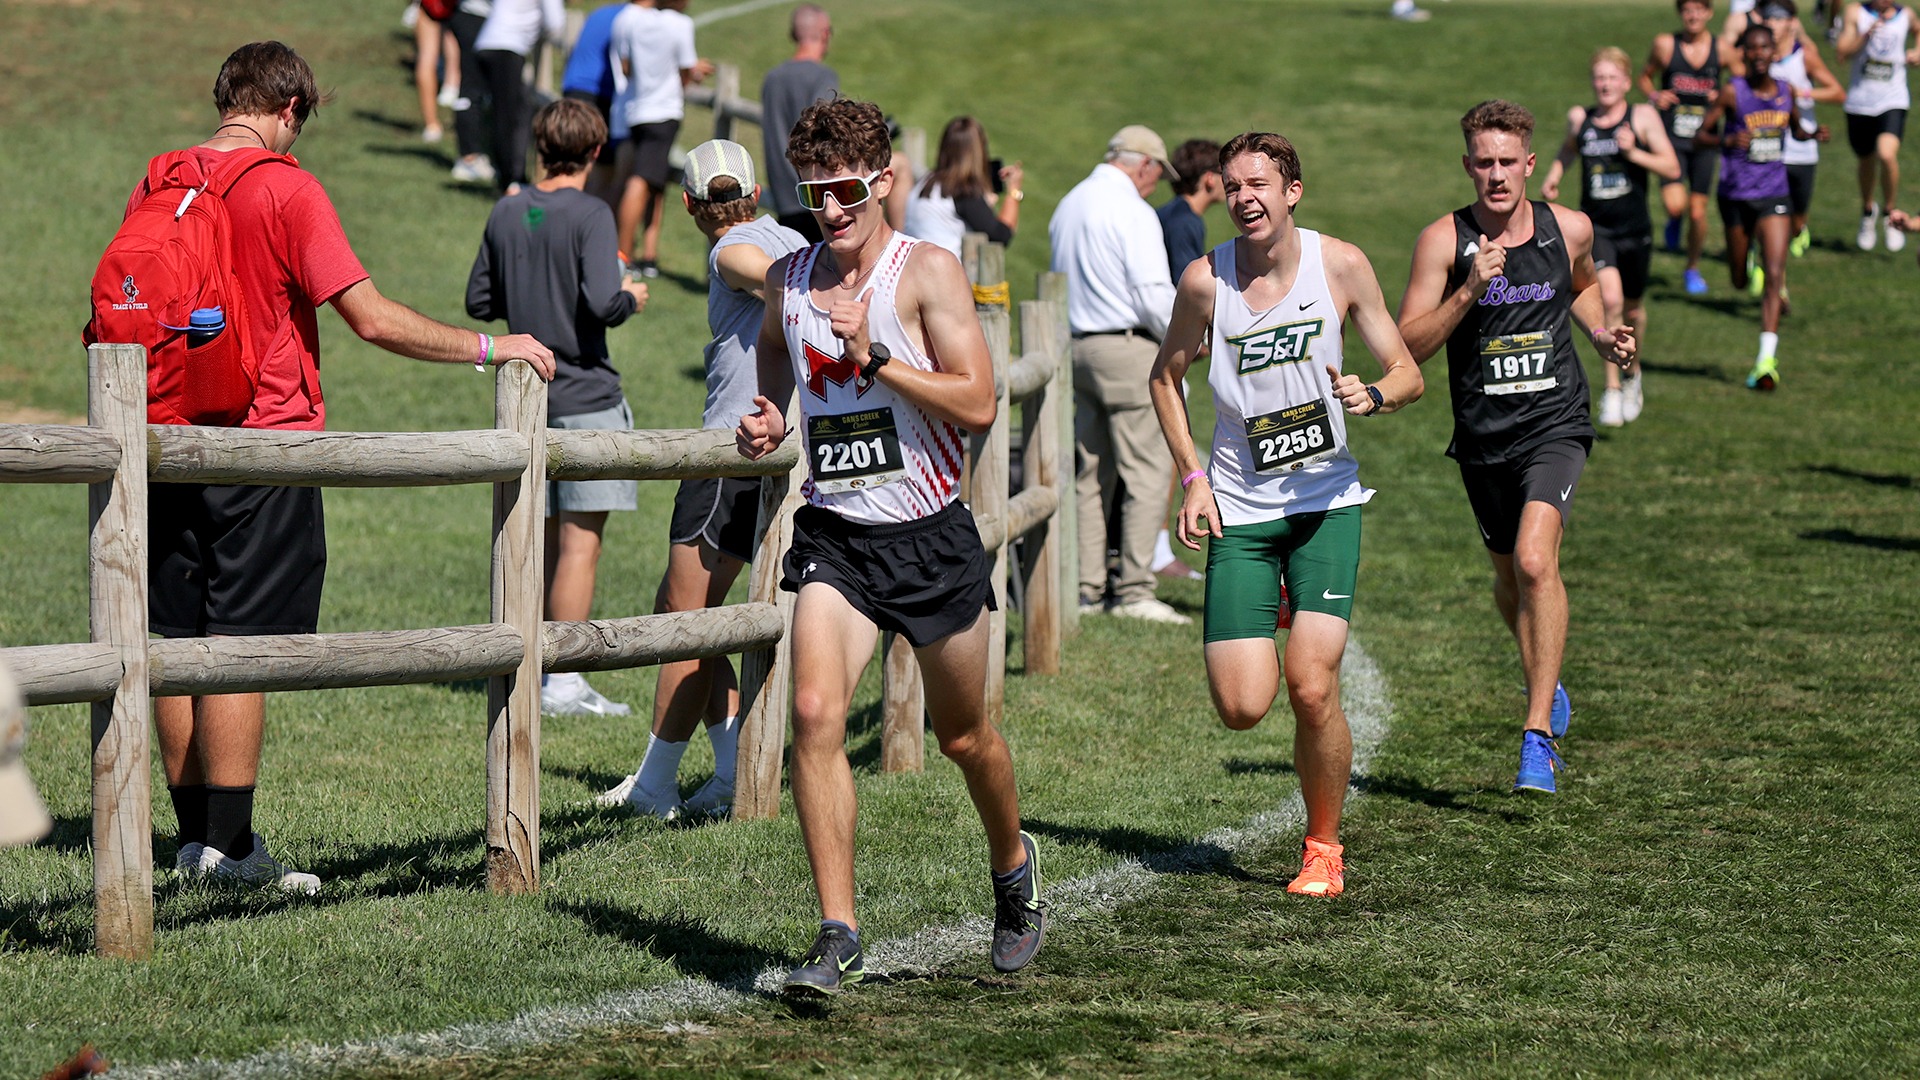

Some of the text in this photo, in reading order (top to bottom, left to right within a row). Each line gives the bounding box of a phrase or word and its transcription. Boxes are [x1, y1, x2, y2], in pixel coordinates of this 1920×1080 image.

[1478, 275, 1556, 305] Bears
[1235, 320, 1320, 372] S&T
[802, 338, 874, 403] M
[1489, 352, 1547, 379] 1917
[842, 412, 880, 423] GANS CREEK
[818, 437, 887, 472] 2201
[1259, 424, 1325, 464] 2258
